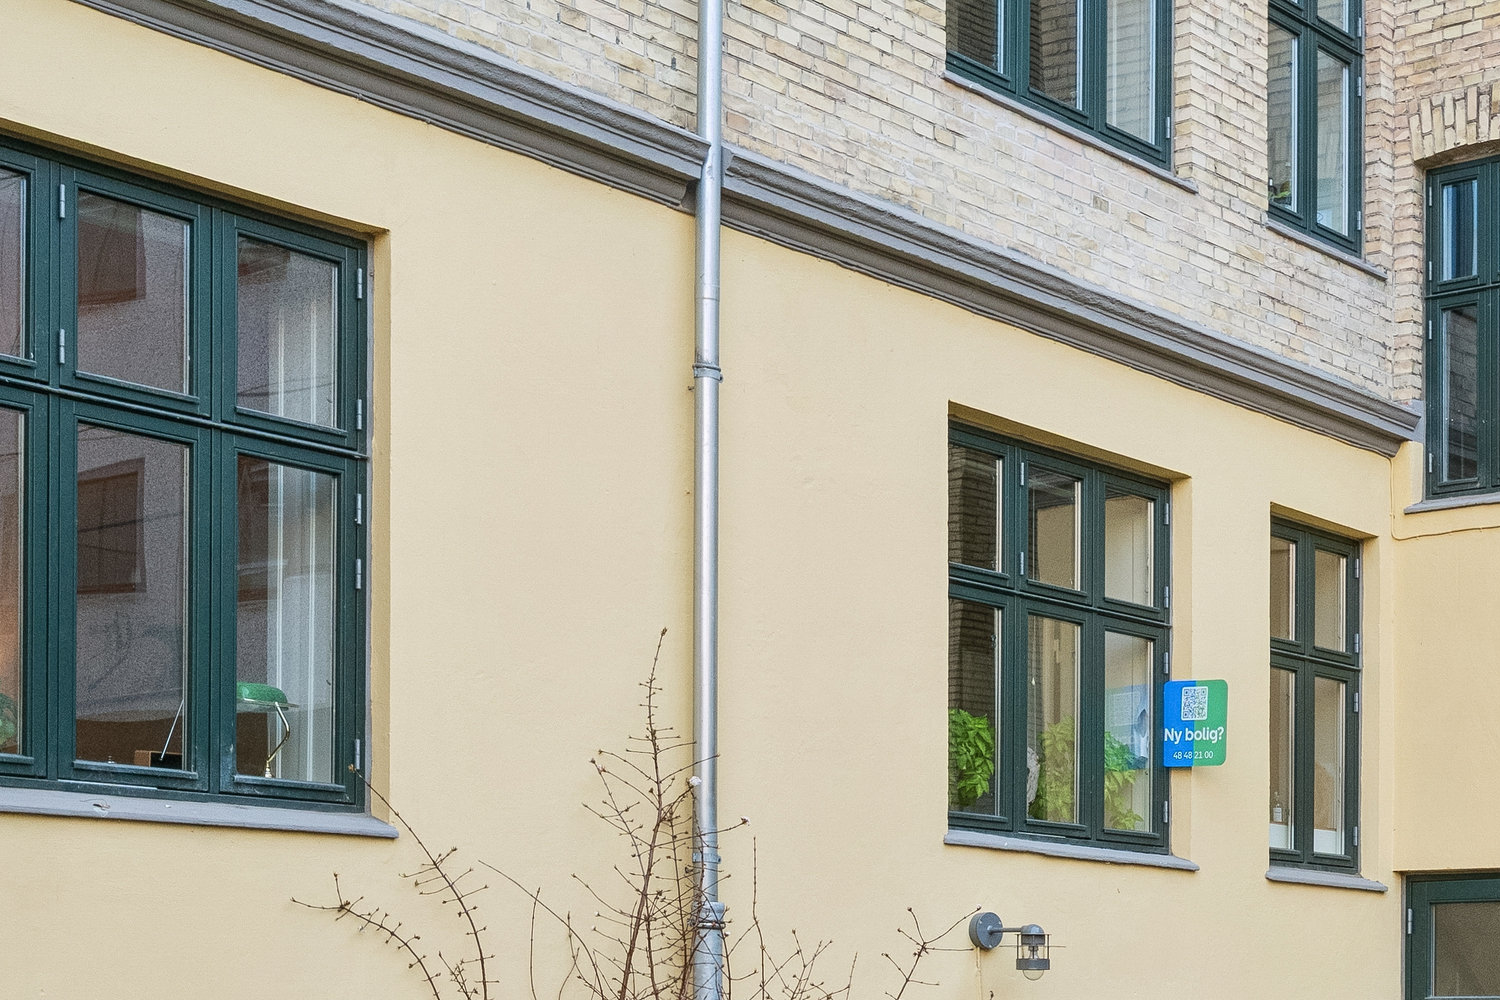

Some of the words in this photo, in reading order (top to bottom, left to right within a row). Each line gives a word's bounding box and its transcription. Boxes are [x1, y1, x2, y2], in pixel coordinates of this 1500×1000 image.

[1164, 727, 1182, 744] Ny
[1185, 726, 1224, 743] bolig?
[1173, 751, 1183, 759] 48
[1183, 751, 1193, 759] 48
[1194, 750, 1203, 759] 21
[1204, 750, 1214, 759] 00
